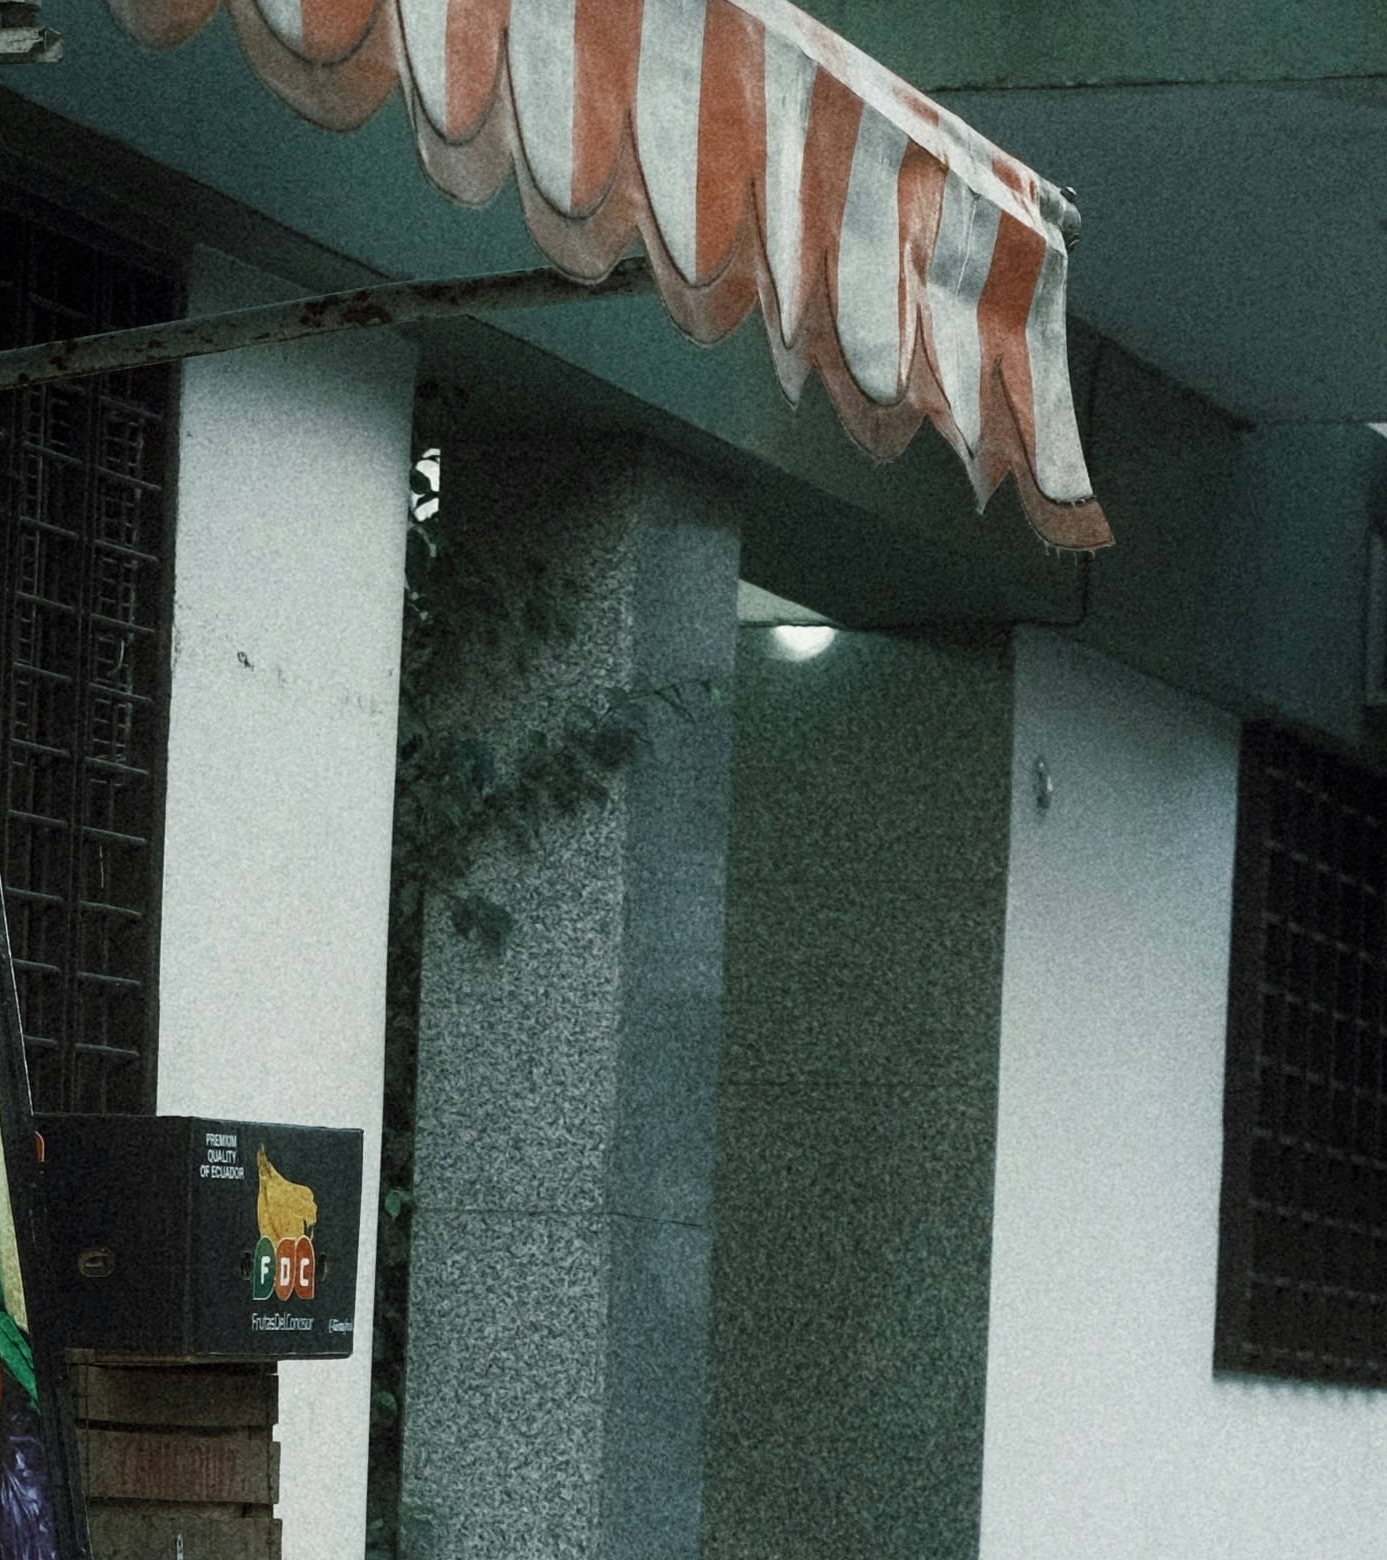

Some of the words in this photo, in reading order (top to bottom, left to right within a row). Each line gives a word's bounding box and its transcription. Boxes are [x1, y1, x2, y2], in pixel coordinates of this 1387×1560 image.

[207, 1149, 237, 1164] QUALITY
[211, 1166, 244, 1180] ECUADOR
[259, 1254, 310, 1288] FDC
